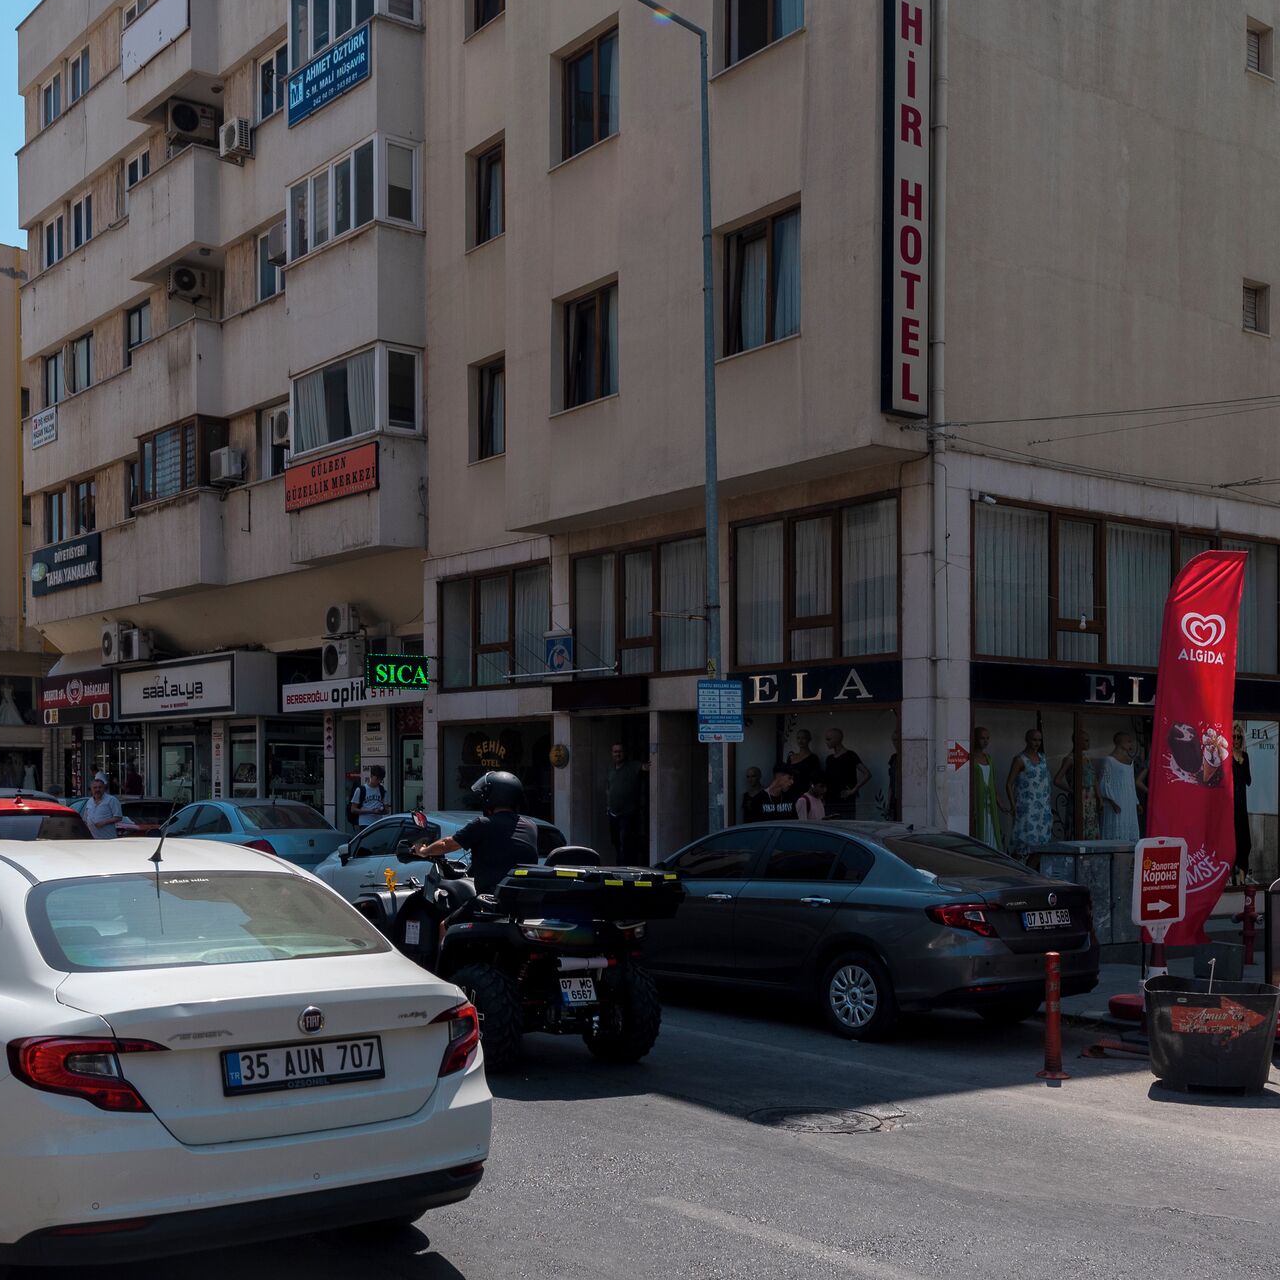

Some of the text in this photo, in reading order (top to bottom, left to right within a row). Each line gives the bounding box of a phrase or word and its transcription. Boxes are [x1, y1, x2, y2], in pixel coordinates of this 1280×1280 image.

[305, 30, 366, 84] AHMET ÖZTÜRK
[319, 70, 335, 90] MALİ
[336, 52, 366, 80] MÜŞAVİR
[900, 177, 922, 402] HOTEL
[311, 456, 347, 478] GÜLBEN
[286, 478, 329, 502] GÜZELLİK
[331, 465, 375, 490] MERKEZİ
[46, 560, 98, 588] TAHA YANALAK
[375, 663, 428, 685] SICA
[286, 689, 329, 705] BERBEROĞLU
[331, 681, 368, 708] optik
[748, 668, 873, 704] ELA
[1251, 728, 1269, 740] ELA
[475, 740, 507, 760] ŞEHİR
[481, 759, 501, 768] OTEL
[1143, 869, 1177, 885] Корона
[1151, 862, 1179, 871] Золотая
[1026, 913, 1036, 926] 07
[1039, 911, 1054, 925] BJT
[561, 979, 592, 989] 07 MC
[571, 990, 592, 1000] 6567
[304, 1014, 321, 1030] FIAT
[240, 1042, 375, 1081] 35 AUN 707
[229, 1071, 241, 1081] TR
